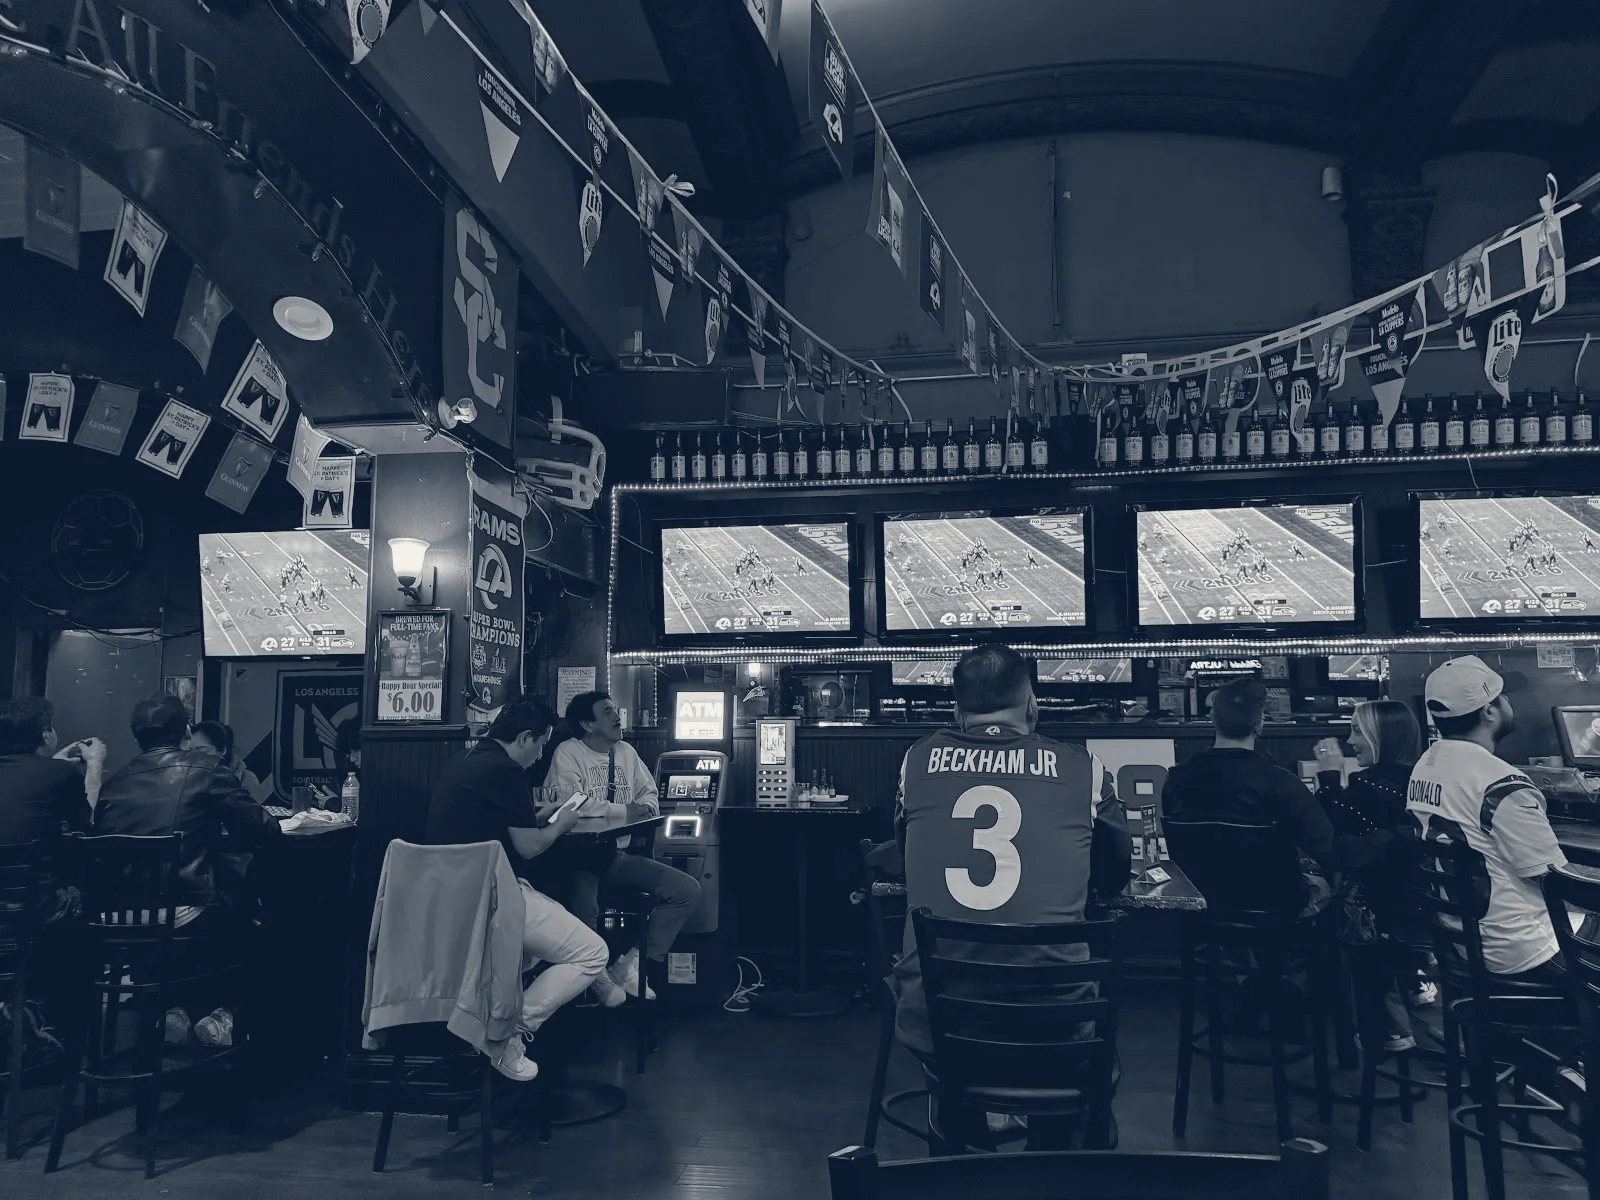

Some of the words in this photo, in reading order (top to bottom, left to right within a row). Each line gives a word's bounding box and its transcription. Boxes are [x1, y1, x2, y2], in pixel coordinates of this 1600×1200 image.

[829, 51, 844, 81] BUD
[826, 59, 846, 95] LIGHT
[478, 74, 492, 96] LOS
[492, 89, 521, 126] ANGELES
[879, 214, 891, 234] BUD
[1493, 316, 1520, 348] Lite
[1365, 364, 1378, 377] LOS
[174, 421, 186, 430] DAY
[220, 472, 249, 493] GUINNESS
[473, 502, 521, 546] RAMS
[1504, 599, 1521, 609] 27
[1544, 599, 1560, 609] 31
[1219, 606, 1235, 616] 27
[1258, 605, 1272, 616] 31
[395, 615, 421, 624] BREWED
[421, 615, 434, 623] FOR
[733, 618, 747, 626] 27
[766, 617, 778, 626] 31
[959, 612, 974, 622] 27
[995, 612, 1008, 622] 31
[390, 623, 424, 631] FULL-TIME
[493, 616, 516, 632] BOWL
[280, 637, 295, 647] 27
[316, 637, 330, 647] 31
[381, 682, 401, 690] Happy
[402, 682, 417, 690] Hour
[418, 681, 442, 690] Special!
[295, 687, 314, 697] LOS
[314, 687, 359, 696] ANGELES
[386, 691, 435, 713] $6.00
[679, 701, 721, 718] ATM
[695, 759, 720, 770] ATM
[927, 746, 1025, 774] BECKHAM
[1029, 748, 1059, 778] JR
[1409, 779, 1442, 807] DONALD
[944, 784, 1023, 911] 3
